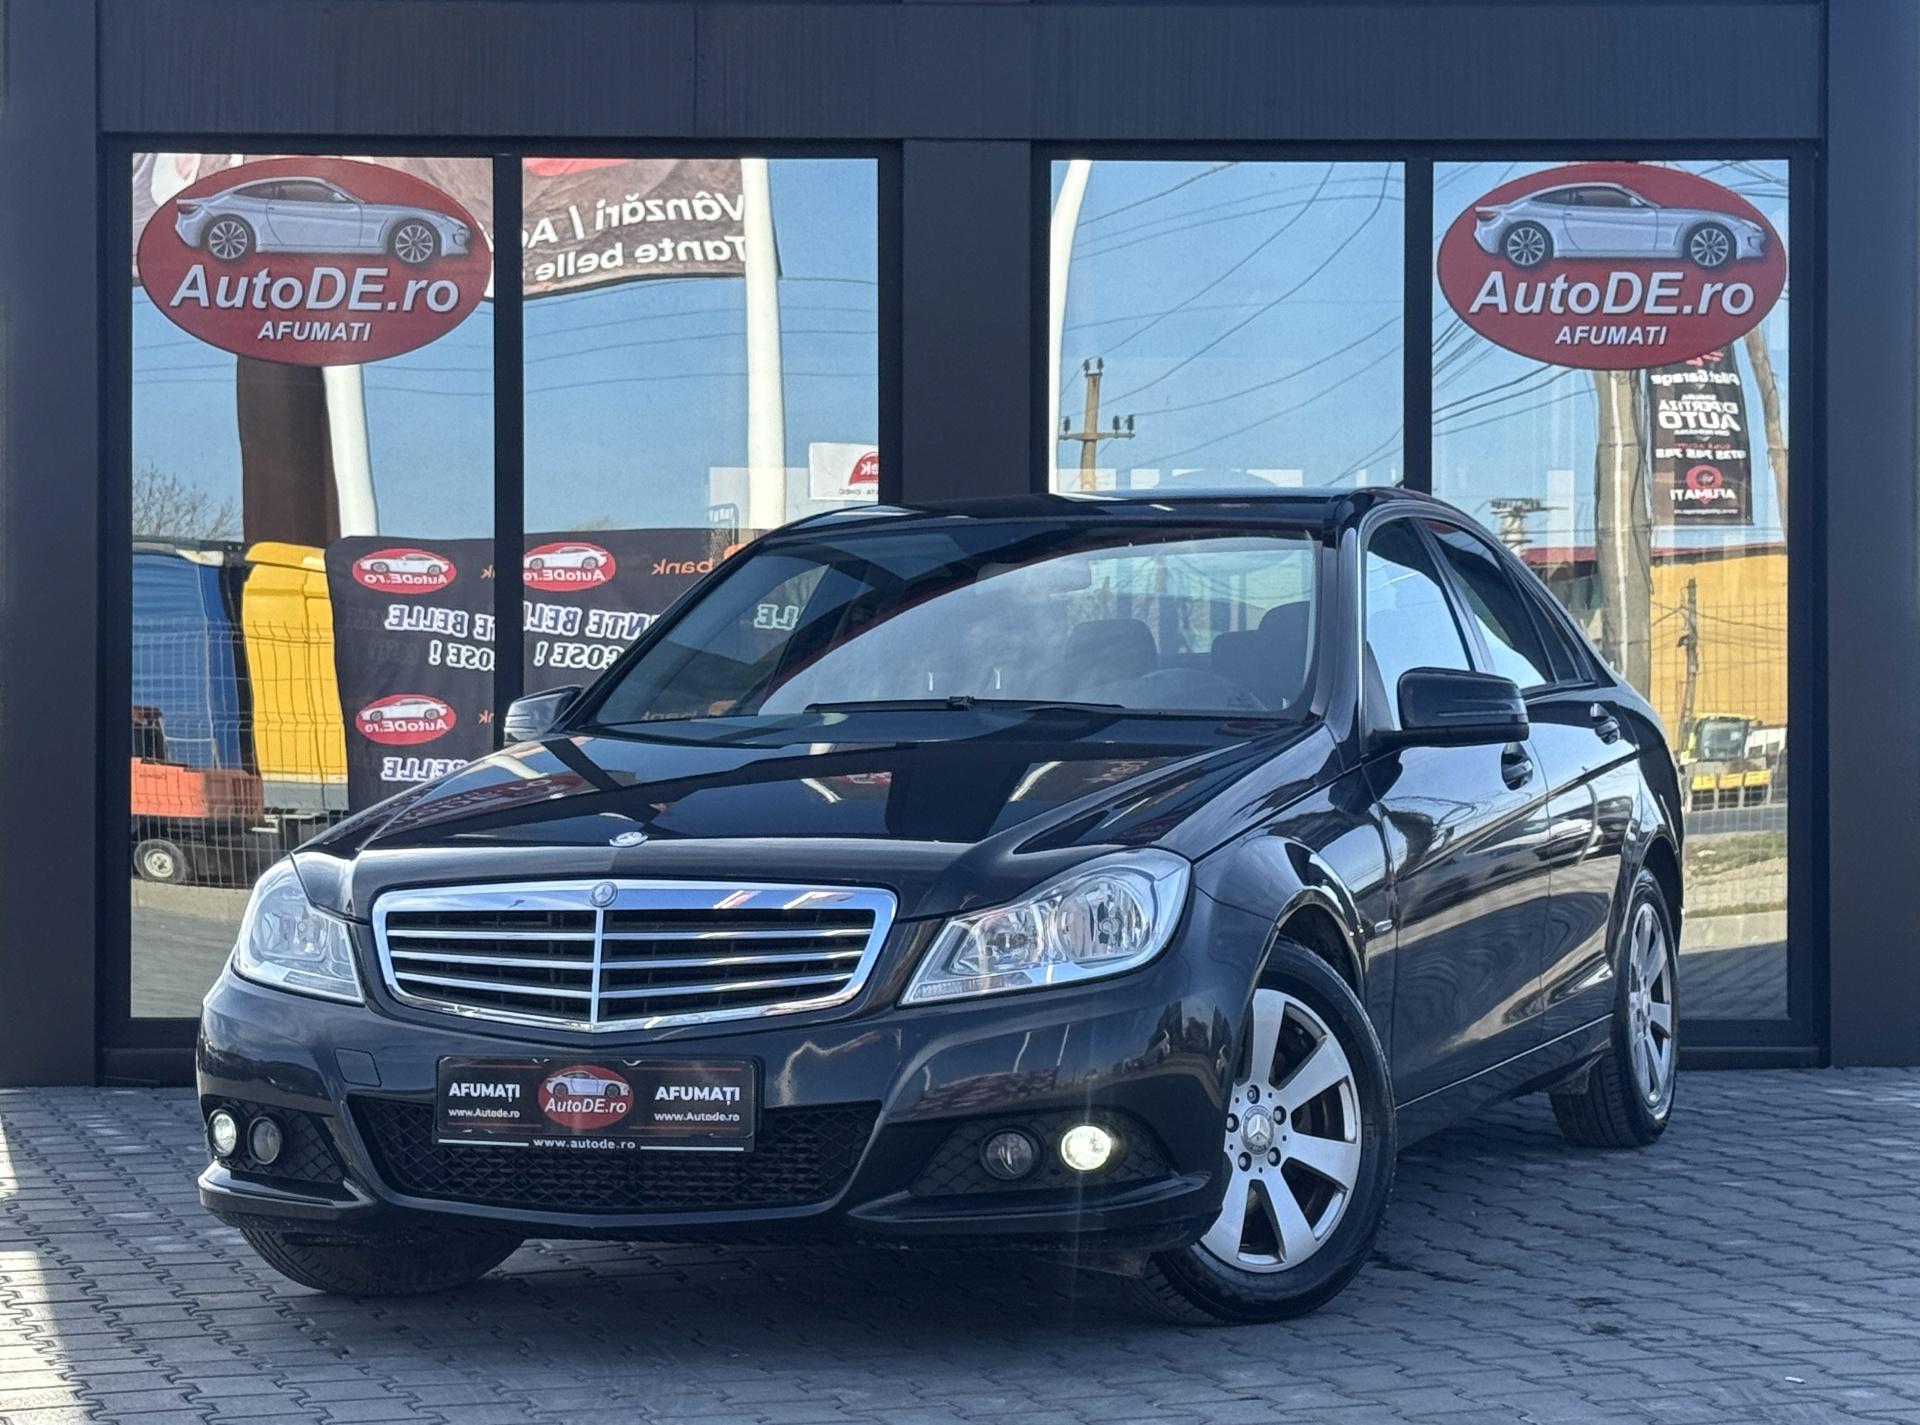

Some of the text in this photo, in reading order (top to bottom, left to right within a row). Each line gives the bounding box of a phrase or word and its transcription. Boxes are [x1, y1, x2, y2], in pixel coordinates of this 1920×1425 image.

[169, 263, 460, 313] AutoDE.ro
[1468, 270, 1755, 316] AutoDE.ro
[257, 321, 372, 342] AFUMATI
[1555, 326, 1667, 346] AFUMATI
[448, 1107, 521, 1119] www.Autode.ro
[544, 1096, 628, 1115] AutoDE.ro
[654, 1111, 740, 1123] www.Autode.ro
[533, 1137, 636, 1150] www.autode.ro
